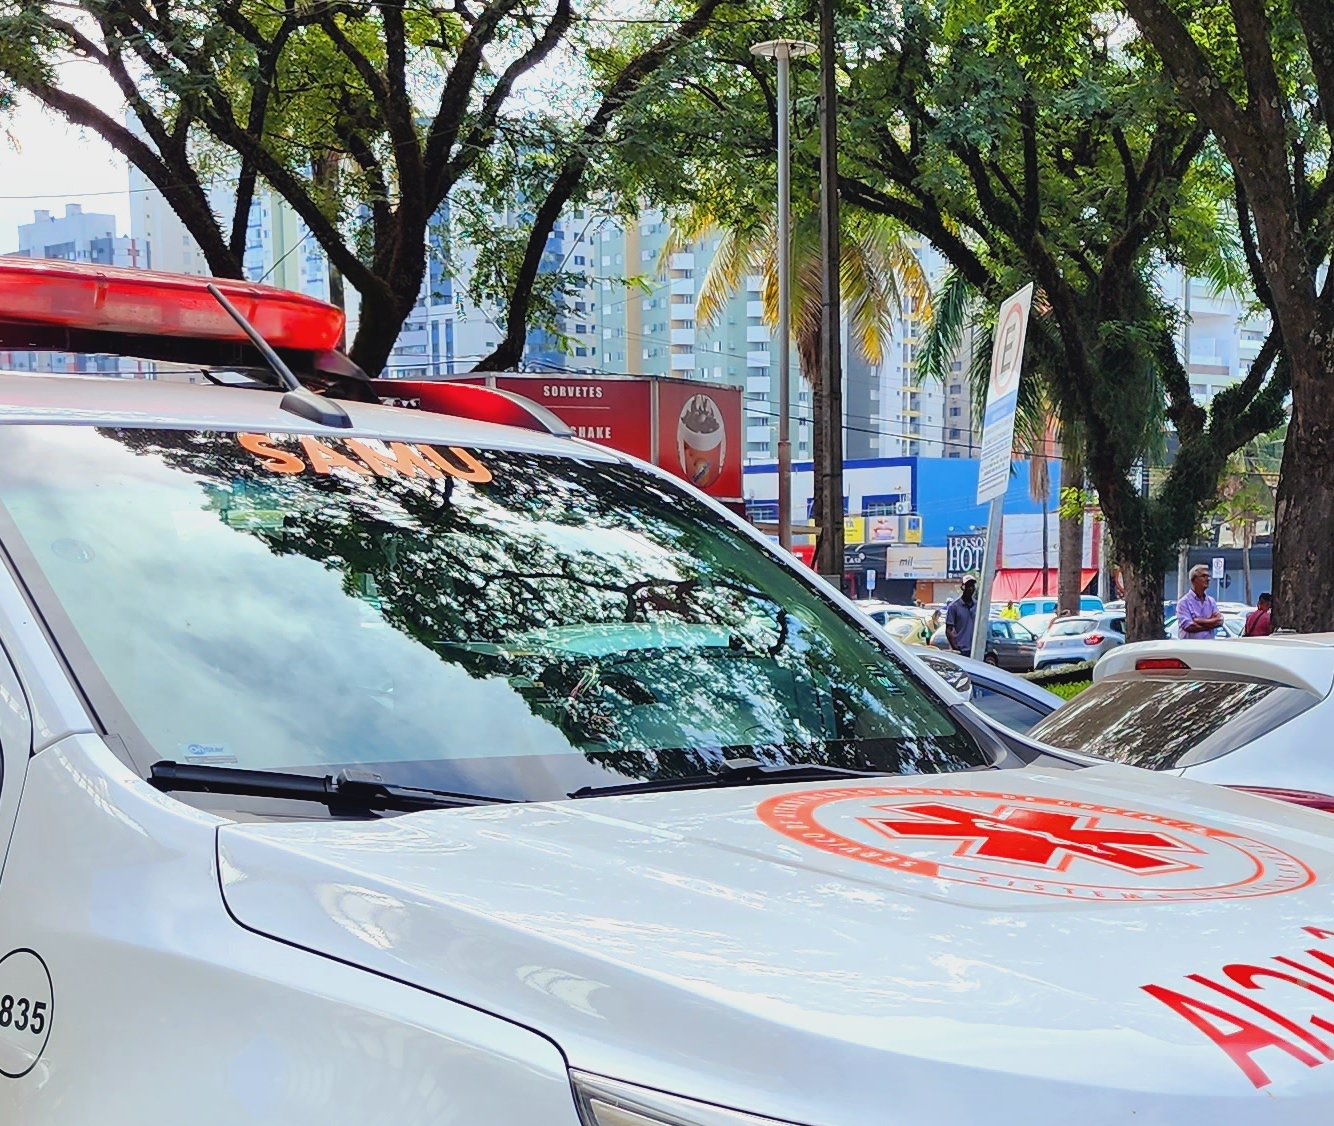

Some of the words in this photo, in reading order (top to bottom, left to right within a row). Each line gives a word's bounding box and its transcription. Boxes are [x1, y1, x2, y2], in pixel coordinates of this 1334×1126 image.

[543, 385, 603, 398] SORVETES
[237, 431, 493, 483] SAMU
[948, 547, 983, 572] HOT
